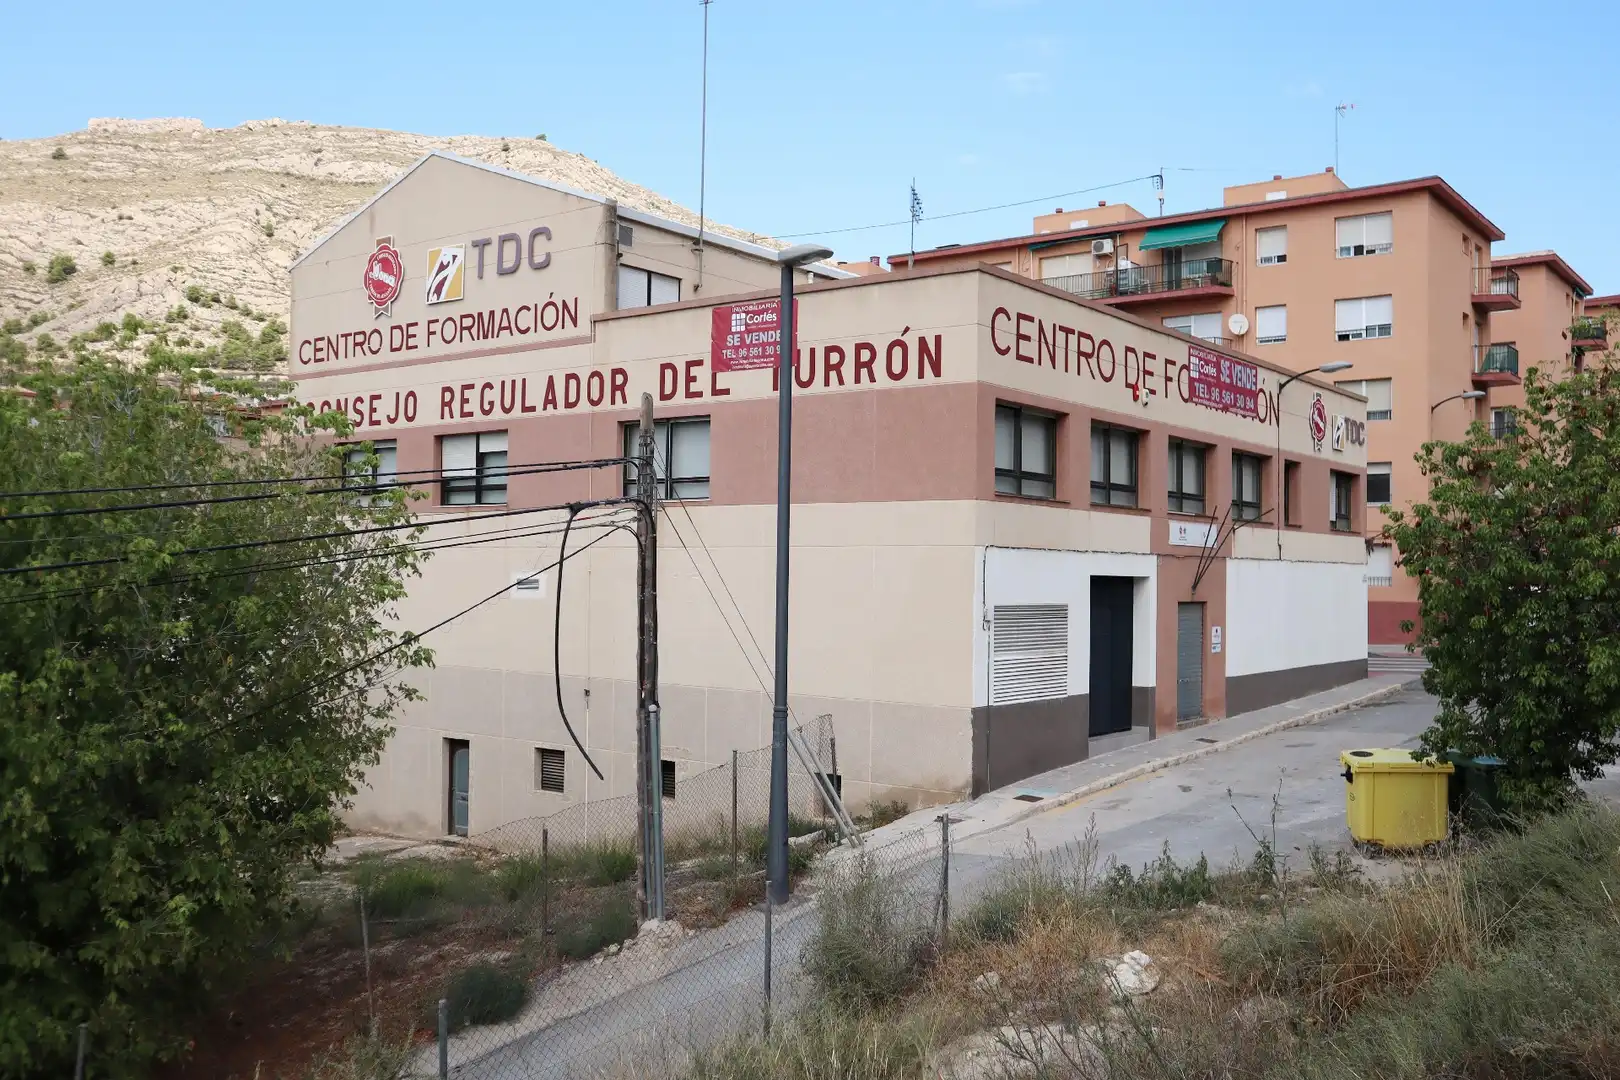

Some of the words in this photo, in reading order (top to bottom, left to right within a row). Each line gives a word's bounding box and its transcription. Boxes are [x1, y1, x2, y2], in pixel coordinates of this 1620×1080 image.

[471, 226, 552, 279] TDC
[732, 303, 777, 312] INMOBILIARIA
[746, 310, 777, 324] Cortés
[299, 328, 383, 365] CENTRO
[389, 321, 419, 352] DE
[426, 291, 579, 348] FORMACIÓN
[726, 334, 741, 347] SE
[738, 348, 748, 358] 96
[749, 346, 762, 357] 561
[764, 345, 775, 355] 30
[990, 306, 1116, 383] CENTRO
[1124, 345, 1157, 396] DE
[1199, 361, 1216, 376] Cortés
[1220, 359, 1231, 384] SE
[1232, 363, 1256, 390] VENDE
[440, 367, 629, 420] REGULADOR
[1210, 387, 1220, 402] 96
[1221, 390, 1234, 405] 561
[1237, 394, 1244, 408] 30
[1246, 397, 1254, 410] 94
[1344, 416, 1366, 447] TDC
